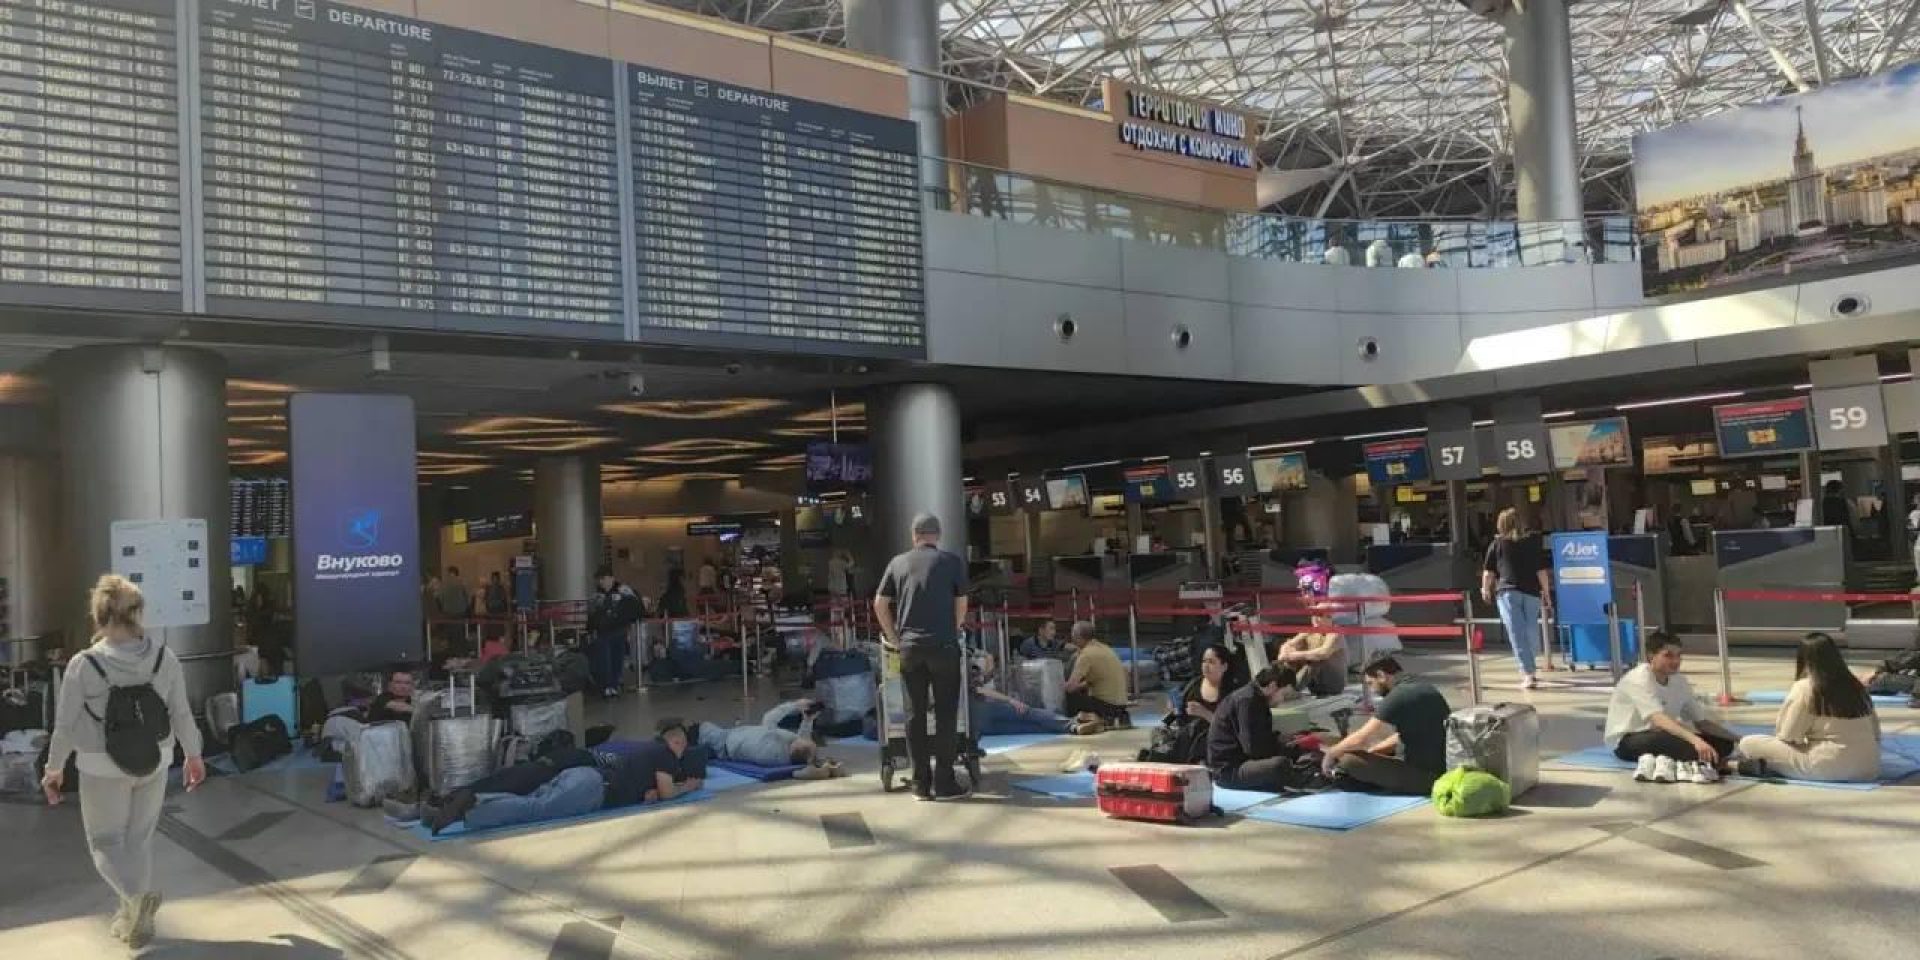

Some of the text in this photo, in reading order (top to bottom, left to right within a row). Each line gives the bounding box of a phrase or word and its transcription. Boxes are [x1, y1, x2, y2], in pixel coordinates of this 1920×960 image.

[329, 9, 433, 41] DEPARTURE
[637, 72, 684, 91] ВЫЛЕТ
[718, 88, 790, 112] DEPARTURE
[1214, 109, 1245, 139] КИНО
[1121, 122, 1254, 168] ОТДОХНИ С КОМФОРТОМ
[1829, 407, 1867, 430] 59
[1441, 447, 1464, 466] 57
[1506, 440, 1535, 459] 58
[1178, 472, 1196, 489] 55
[1223, 468, 1244, 485] 56
[992, 491, 1006, 507] 53
[1025, 487, 1041, 503] 54
[317, 554, 403, 572] Внуково
